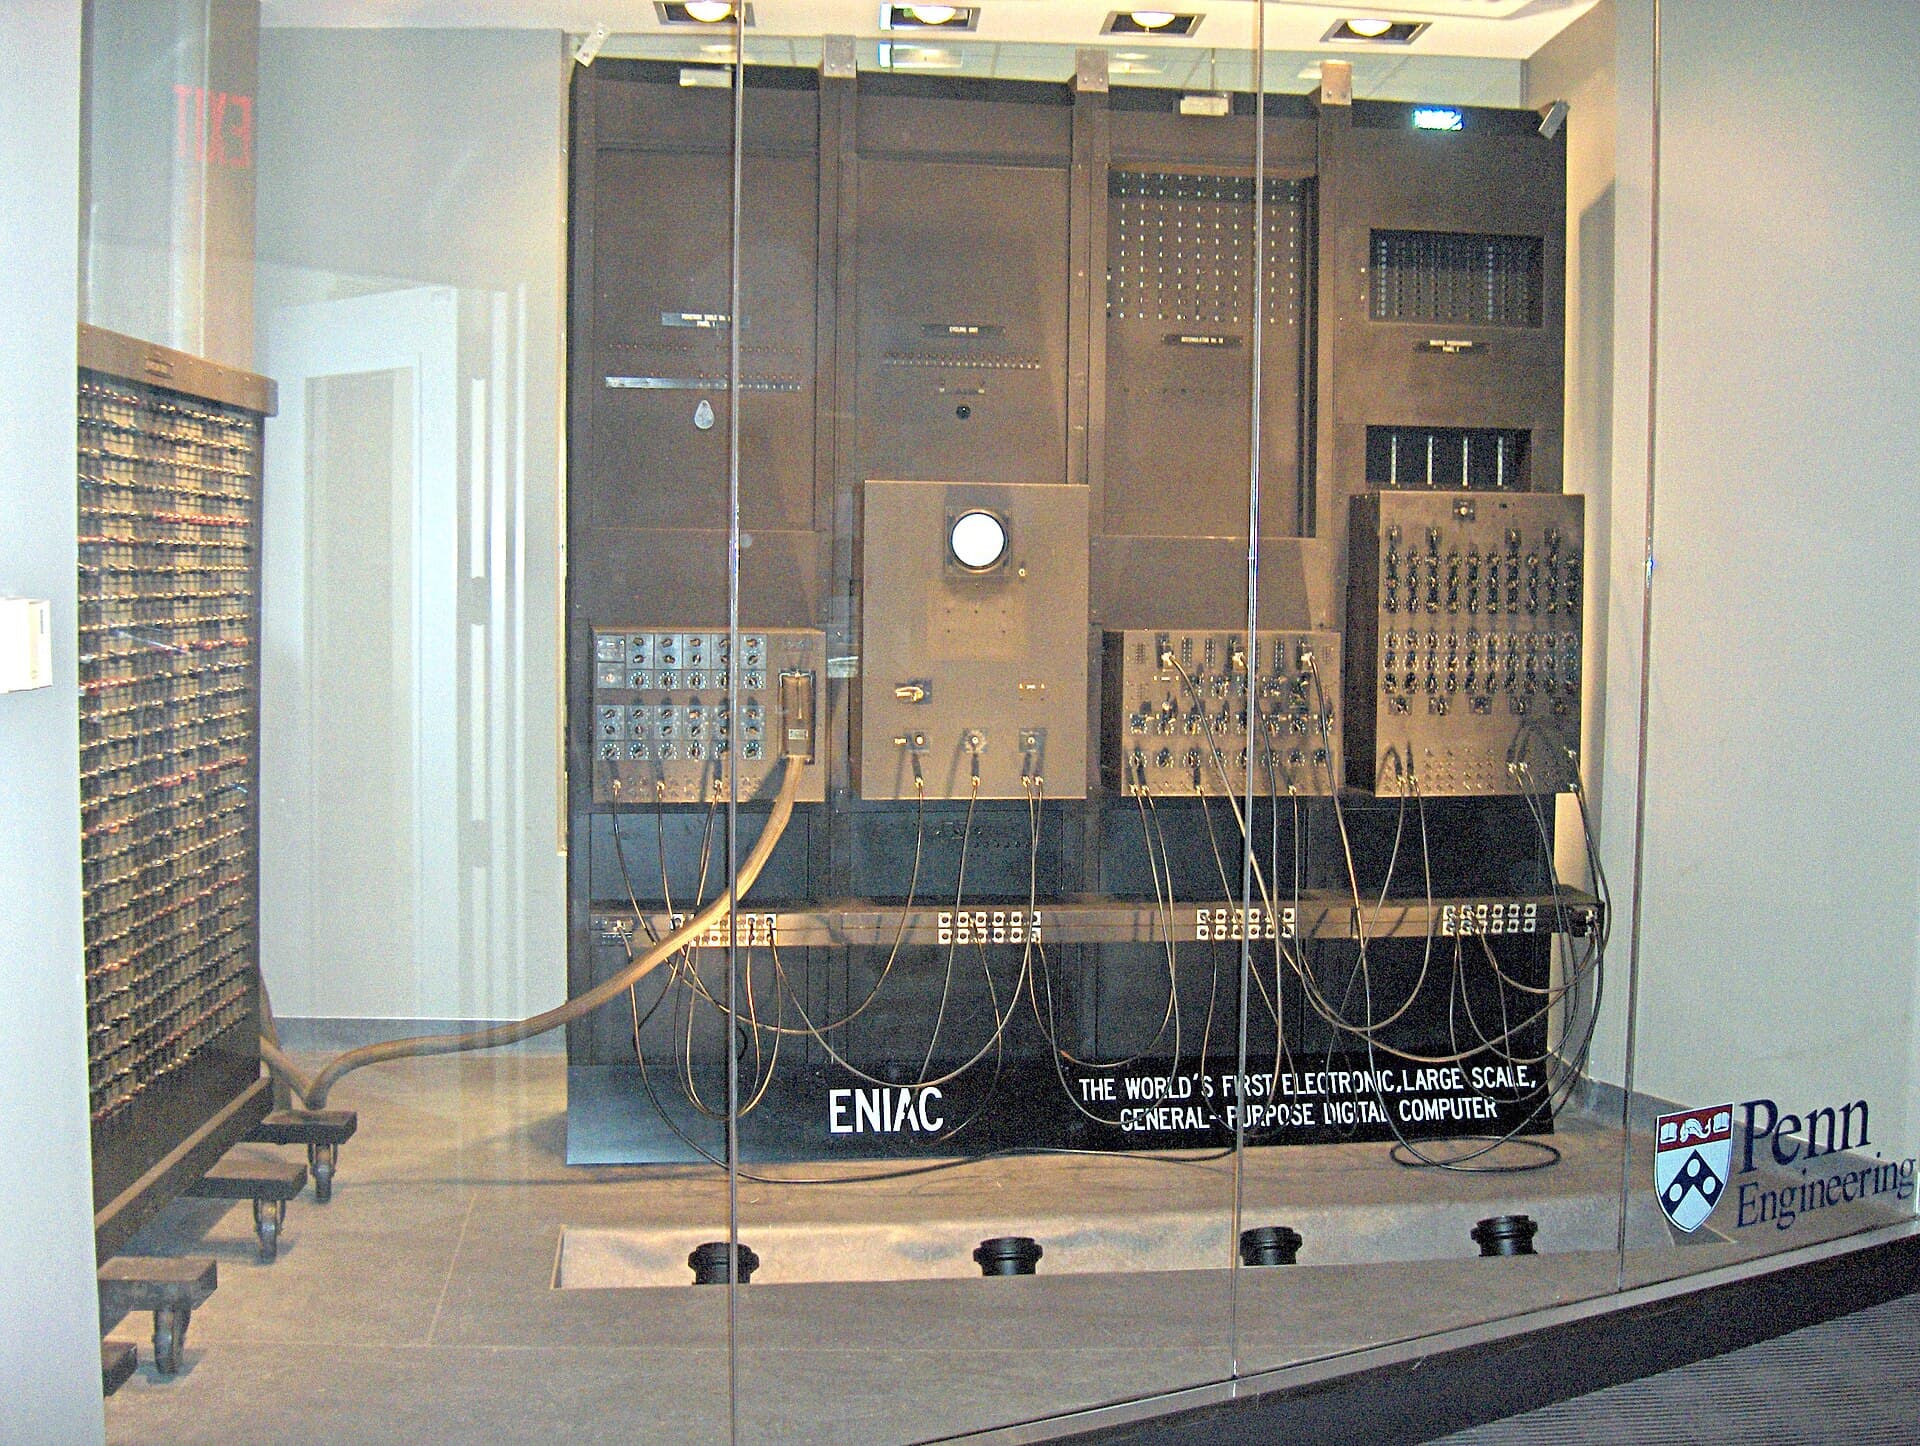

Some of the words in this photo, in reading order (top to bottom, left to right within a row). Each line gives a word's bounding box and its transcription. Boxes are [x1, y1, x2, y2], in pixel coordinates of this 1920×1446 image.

[1079, 1078, 1117, 1100] THE
[1124, 1073, 1214, 1100] WORLD'S
[1222, 1073, 1273, 1097] FIRST
[1471, 1065, 1536, 1089] SCALE,
[829, 1086, 944, 1133] ENIAC
[1226, 1103, 1316, 1128] PURPOSE
[1323, 1100, 1388, 1125] DIGITAL
[1399, 1096, 1498, 1122] COMPUTER
[1739, 1099, 1871, 1174] Penn
[1737, 1151, 1916, 1230] Engineering
